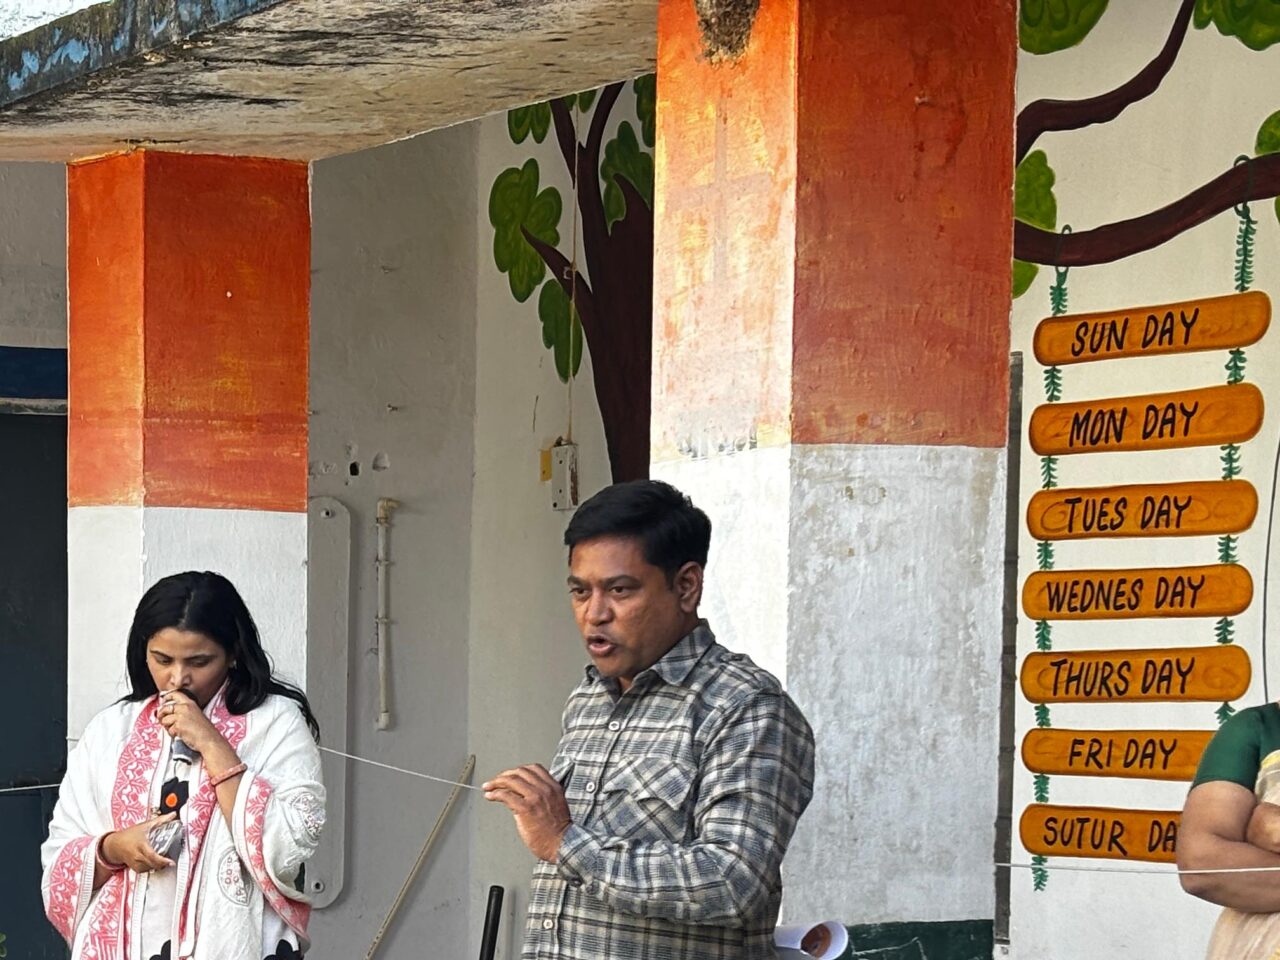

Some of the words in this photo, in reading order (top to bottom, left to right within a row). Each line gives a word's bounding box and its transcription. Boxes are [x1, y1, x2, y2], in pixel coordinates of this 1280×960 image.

[1071, 317, 1129, 357] SUN
[1141, 307, 1200, 349] DAY
[1069, 406, 1128, 447] MON
[1142, 401, 1199, 440] DAY
[1064, 496, 1127, 533] TUES
[1140, 495, 1192, 529] DAY
[1046, 578, 1144, 613] WEDNES
[1154, 574, 1206, 609] DAY
[1050, 658, 1132, 698] THURS
[1141, 656, 1195, 695] DAY
[1043, 816, 1127, 856] SUTUR
[1148, 820, 1177, 852] DA
